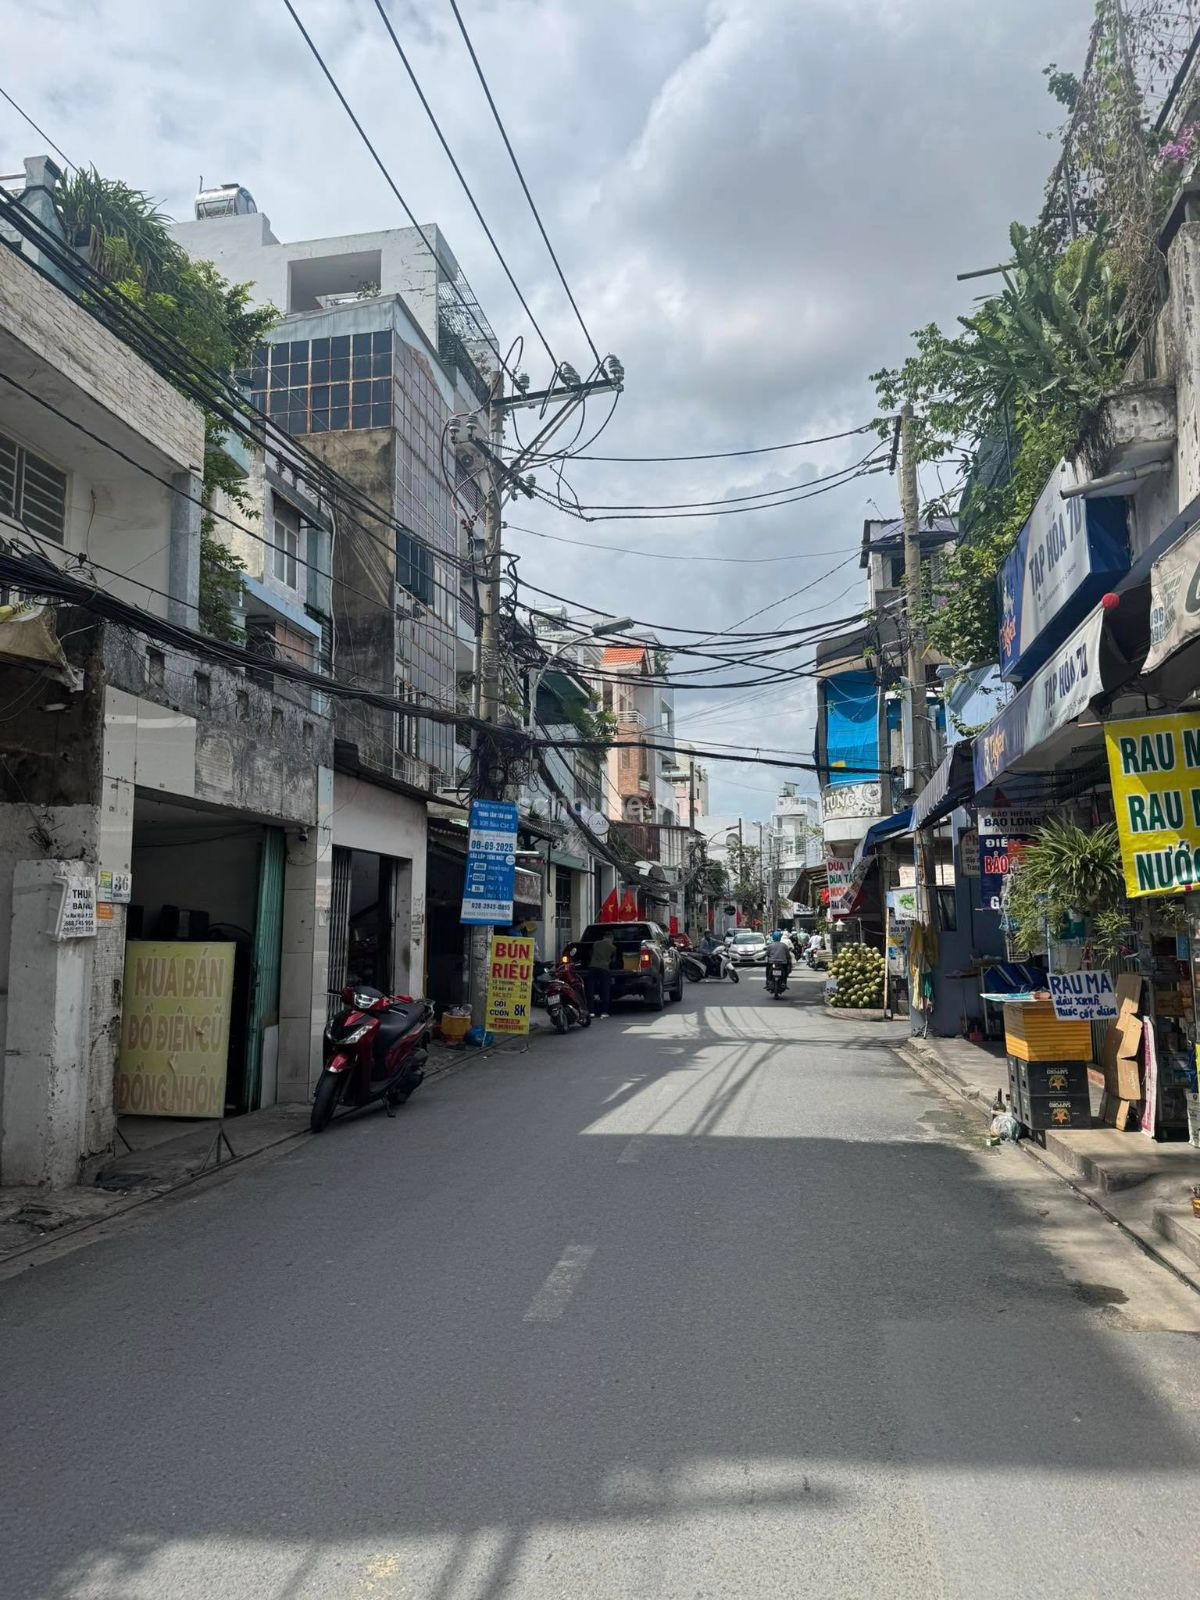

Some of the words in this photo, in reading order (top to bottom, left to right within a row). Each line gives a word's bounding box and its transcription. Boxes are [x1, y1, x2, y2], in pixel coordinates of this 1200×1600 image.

[1119, 732, 1175, 775] RAU
[1127, 791, 1185, 833] RAU
[495, 939, 530, 960] BÚN
[135, 957, 178, 998] MUA
[181, 946, 225, 998] BÁN
[491, 960, 530, 981] RIÊU
[1050, 974, 1084, 995] RAU
[514, 1003, 526, 1017] 8K
